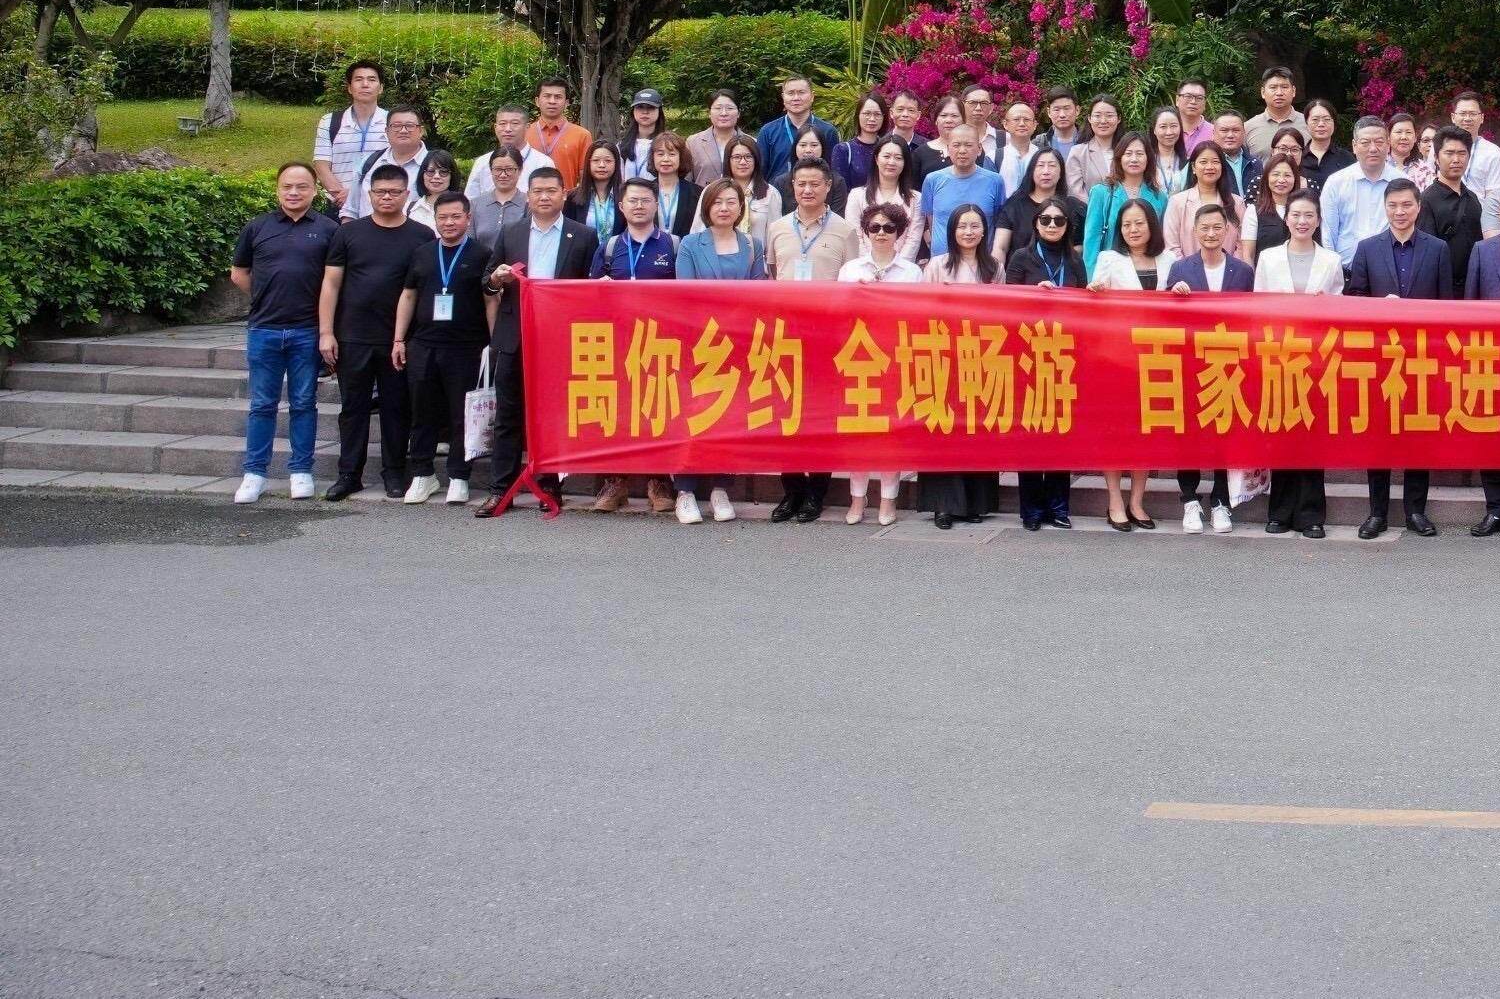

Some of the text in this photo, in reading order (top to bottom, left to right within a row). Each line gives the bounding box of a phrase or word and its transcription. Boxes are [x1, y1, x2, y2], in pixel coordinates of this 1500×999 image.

[568, 317, 802, 437] 禺你乡约
[833, 319, 1077, 434] 全域畅游
